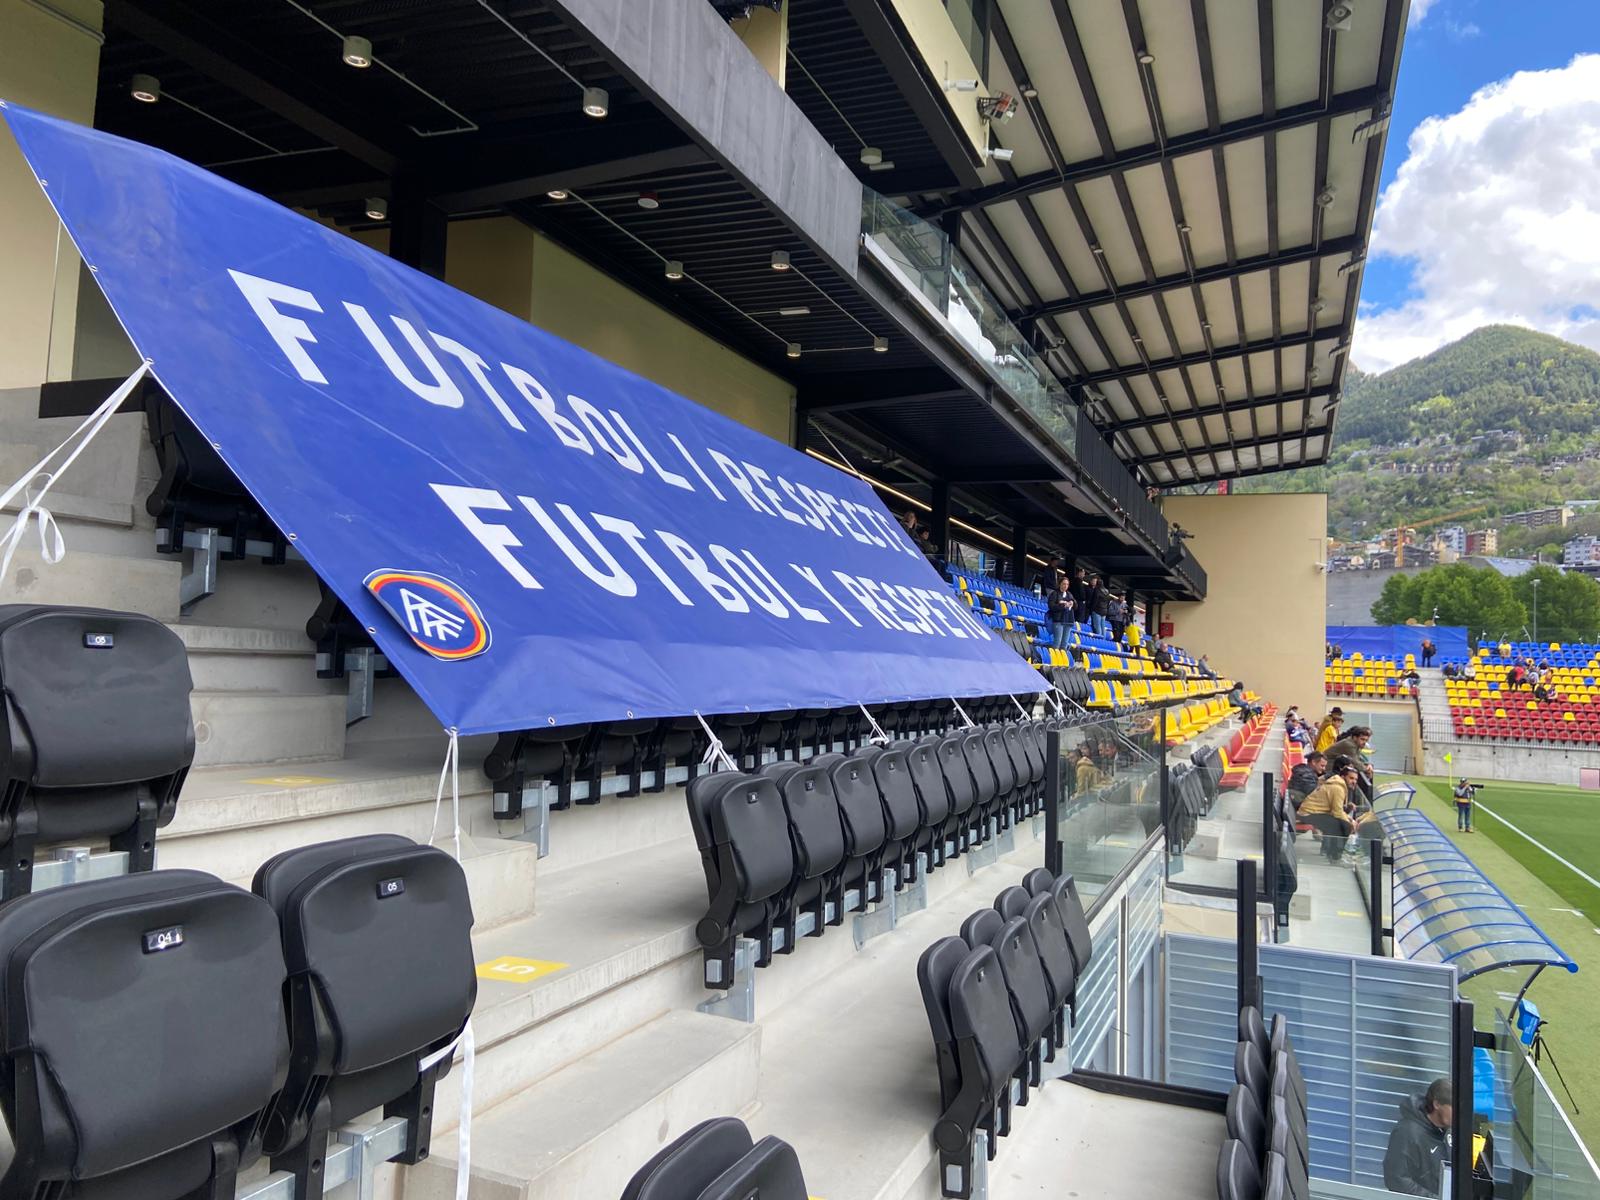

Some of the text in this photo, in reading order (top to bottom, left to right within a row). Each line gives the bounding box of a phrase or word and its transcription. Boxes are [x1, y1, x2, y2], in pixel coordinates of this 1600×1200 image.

[227, 268, 920, 560] FUTBOL I RESPECTE
[428, 483, 991, 641] FUTBOL Y RESPETO
